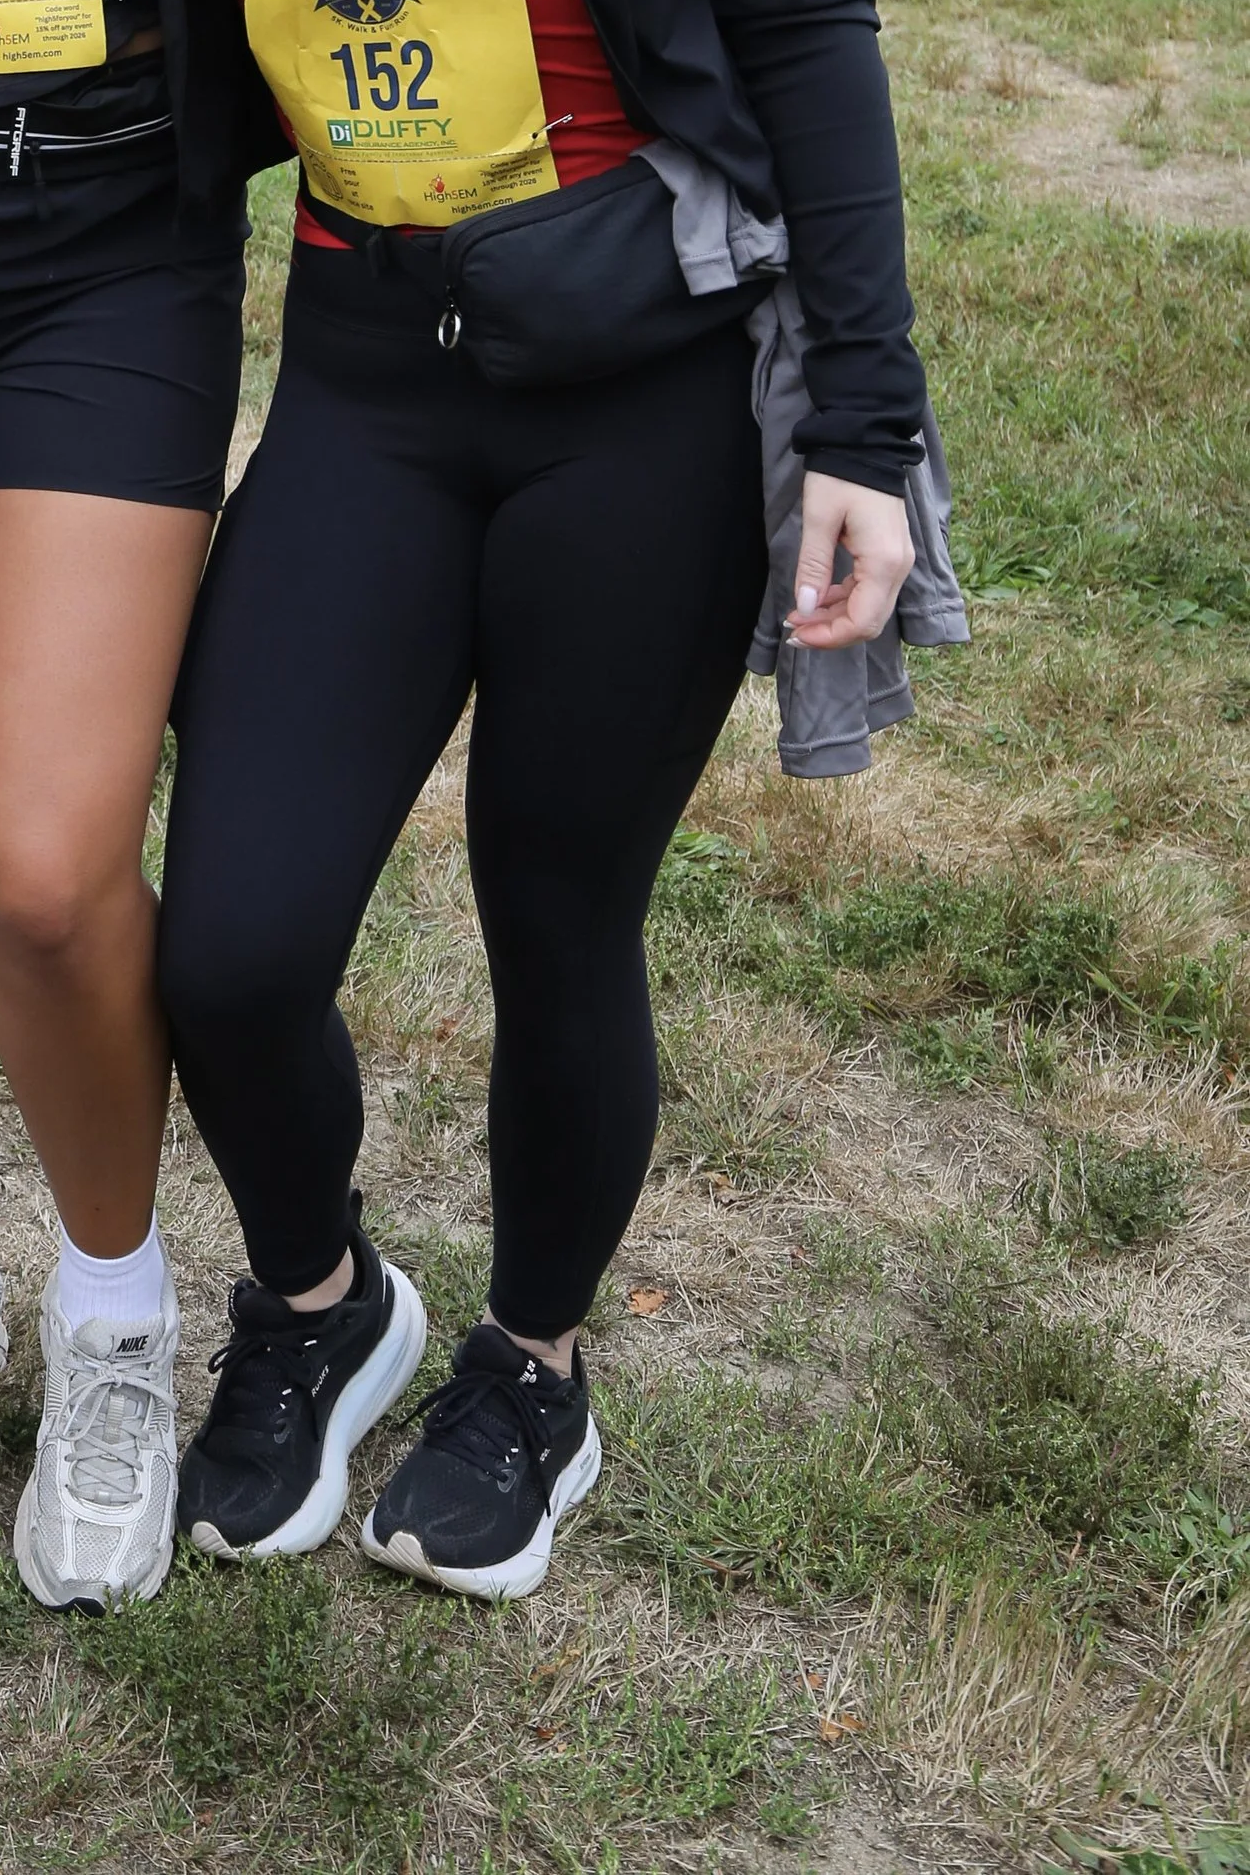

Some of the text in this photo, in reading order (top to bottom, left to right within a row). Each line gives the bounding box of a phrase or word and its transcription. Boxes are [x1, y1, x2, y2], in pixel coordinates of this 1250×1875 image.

[63, 4, 80, 12] word
[50, 24, 60, 32] off
[347, 24, 368, 34] Walk
[370, 26, 377, 34] &
[393, 10, 410, 26] Run
[42, 33, 69, 42] through
[2, 49, 63, 62] high5em.com
[329, 39, 440, 112] 152
[329, 117, 453, 142] Di DUFFY
[10, 107, 27, 177] FITGRIFF
[356, 140, 403, 148] INSURANCE
[523, 168, 543, 176] event
[490, 182, 519, 192] through
[423, 187, 478, 204] High5EM
[451, 196, 514, 214] high5em.com
[116, 1334, 149, 1353] NIKE
